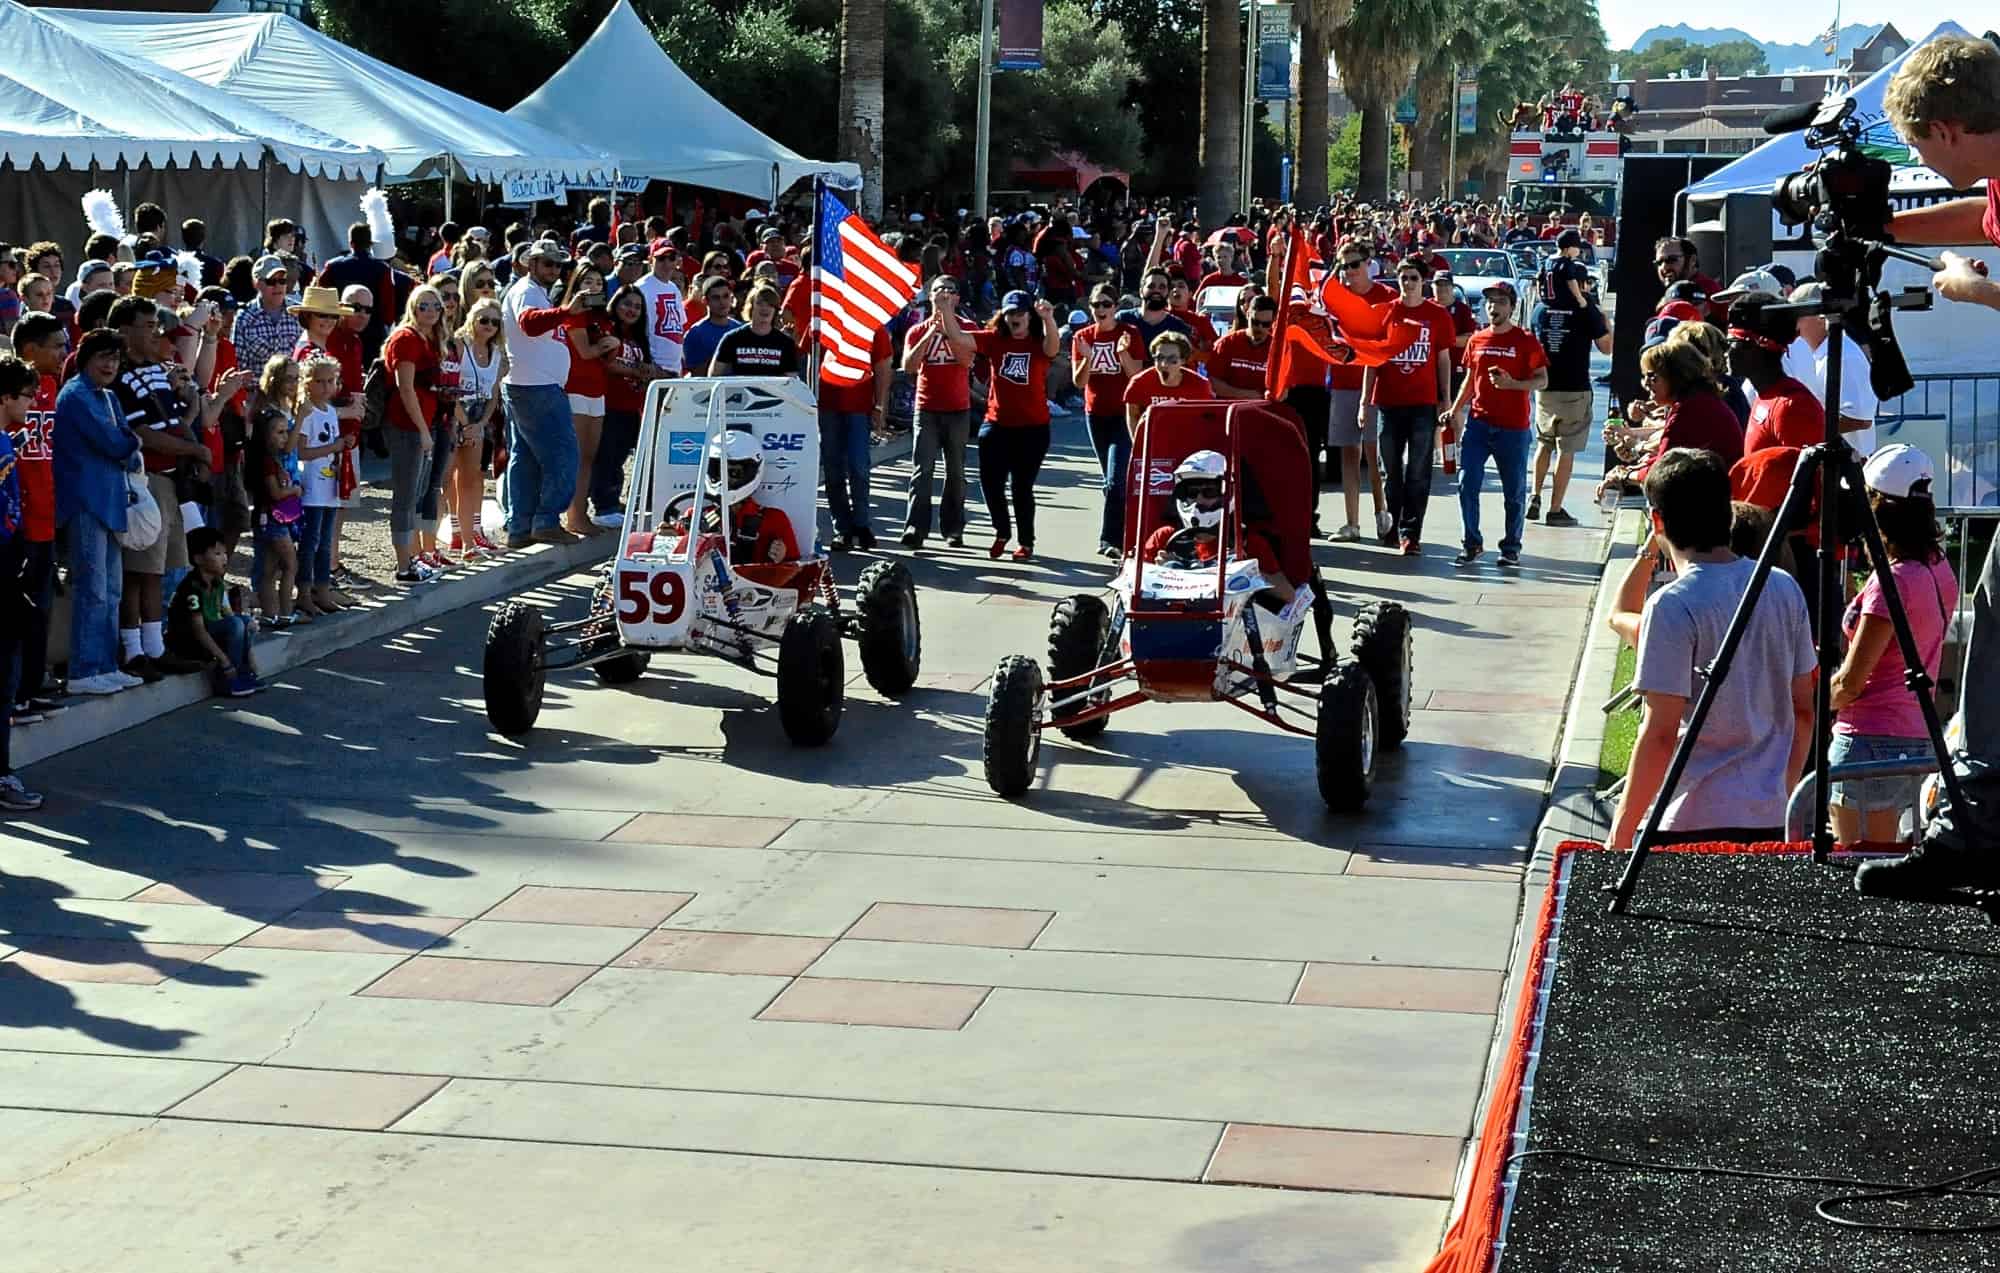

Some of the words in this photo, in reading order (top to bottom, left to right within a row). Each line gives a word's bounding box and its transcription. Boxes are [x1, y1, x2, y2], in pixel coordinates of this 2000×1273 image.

[1262, 24, 1289, 33] CARS
[1089, 341, 1121, 374] A
[762, 432, 806, 450] SAE
[186, 594, 200, 610] 3
[618, 571, 686, 625] 59
